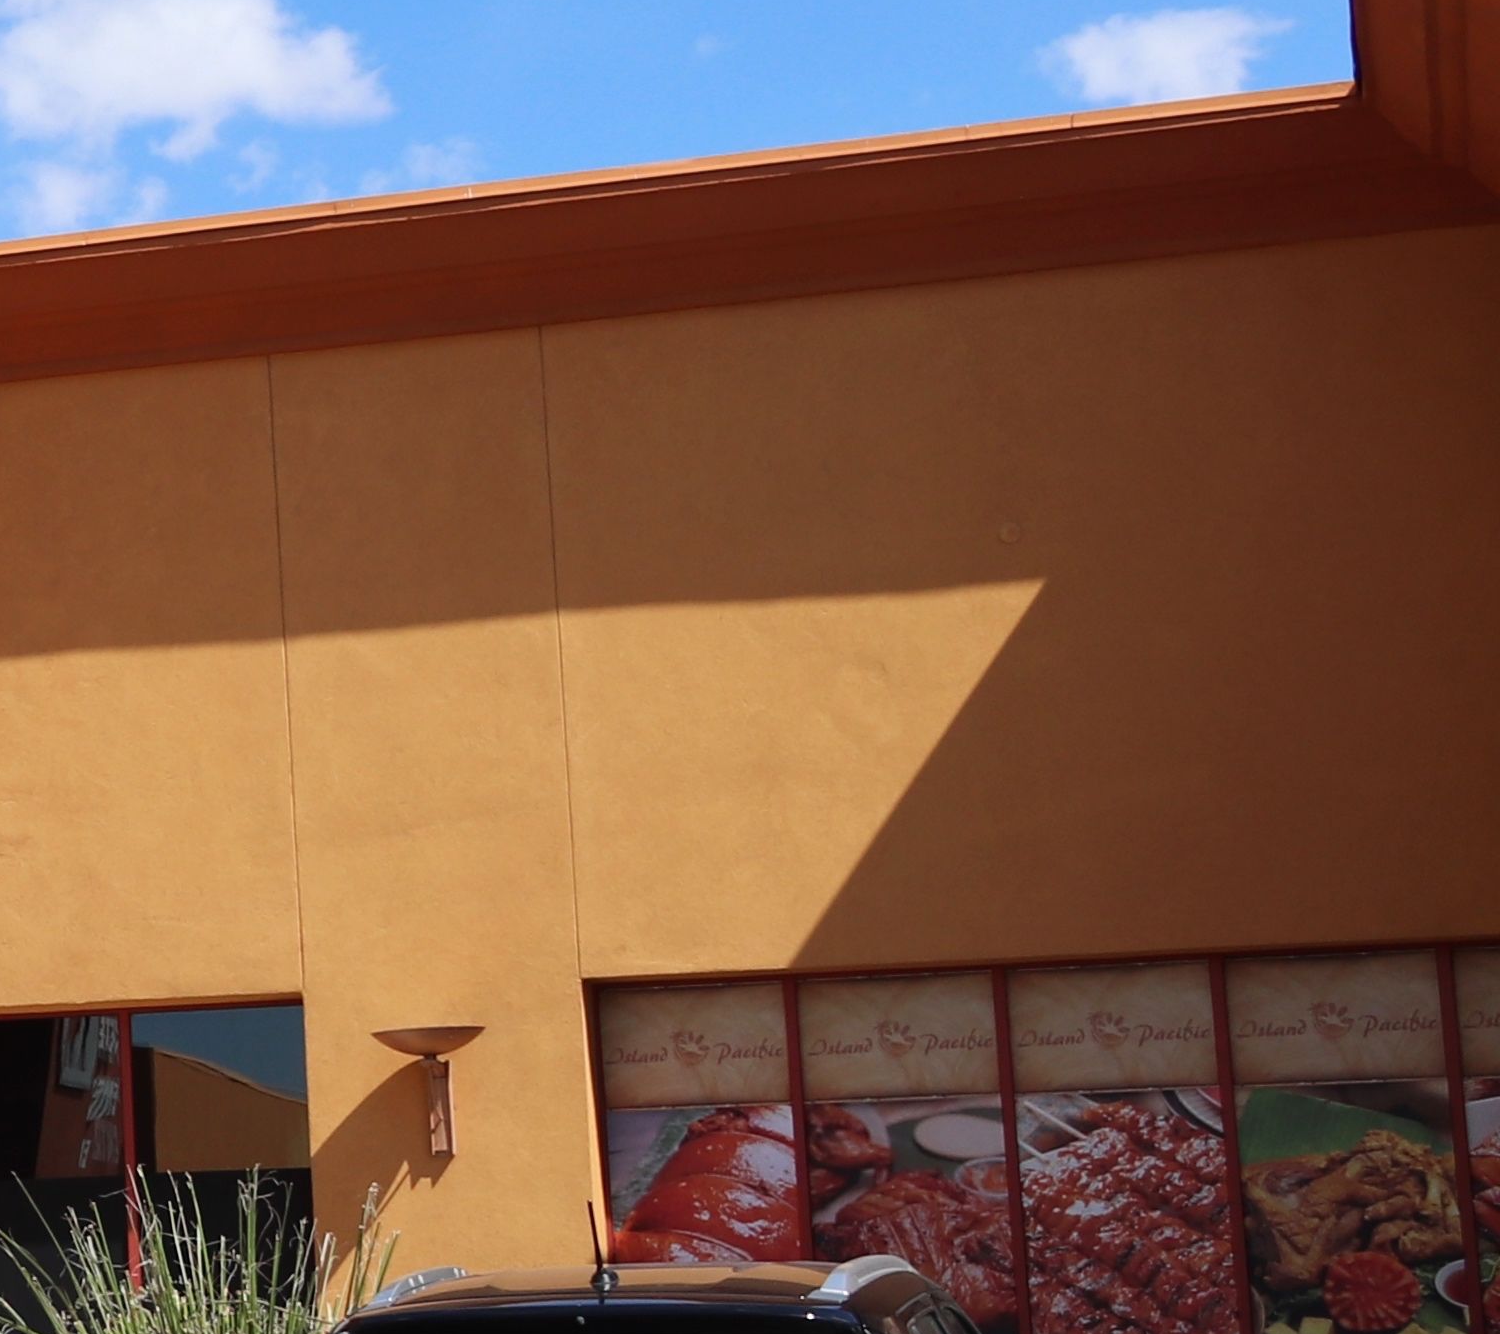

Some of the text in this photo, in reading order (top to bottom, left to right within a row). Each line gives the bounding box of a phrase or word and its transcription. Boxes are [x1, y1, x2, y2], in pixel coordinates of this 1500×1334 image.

[1017, 1019, 1211, 1047] Island Pacific
[1235, 1009, 1437, 1038] Island Pacific
[604, 1038, 782, 1065] Island Pacific
[808, 1029, 994, 1056] Island Pacific
